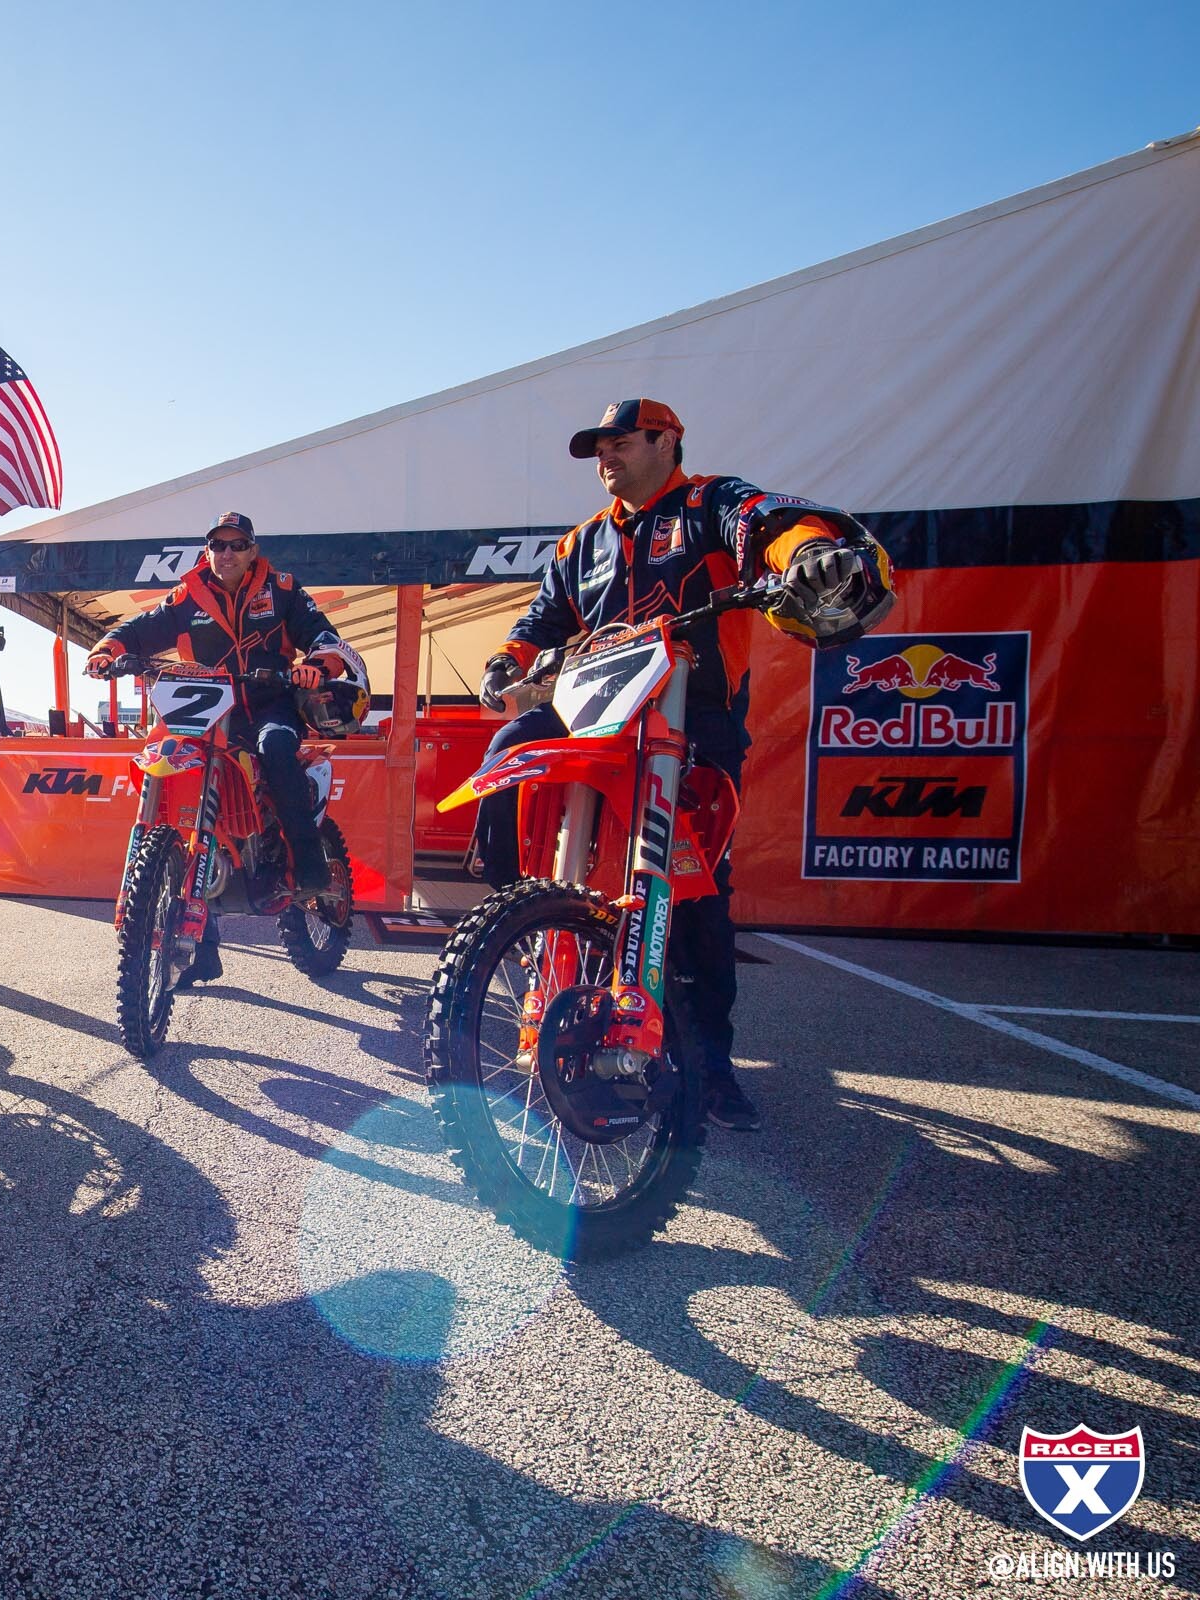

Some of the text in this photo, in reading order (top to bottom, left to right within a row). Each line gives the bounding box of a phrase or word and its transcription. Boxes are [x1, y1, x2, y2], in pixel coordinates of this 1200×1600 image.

[134, 545, 206, 583] KT
[162, 685, 225, 727] 2
[569, 647, 658, 733] 7
[819, 701, 1016, 748] Red Bull
[22, 767, 103, 796] KTM
[839, 776, 988, 818] KTM
[196, 834, 210, 889] DUNLP
[814, 845, 1011, 870] FACTORY RACING
[648, 895, 670, 968] MOTOREX
